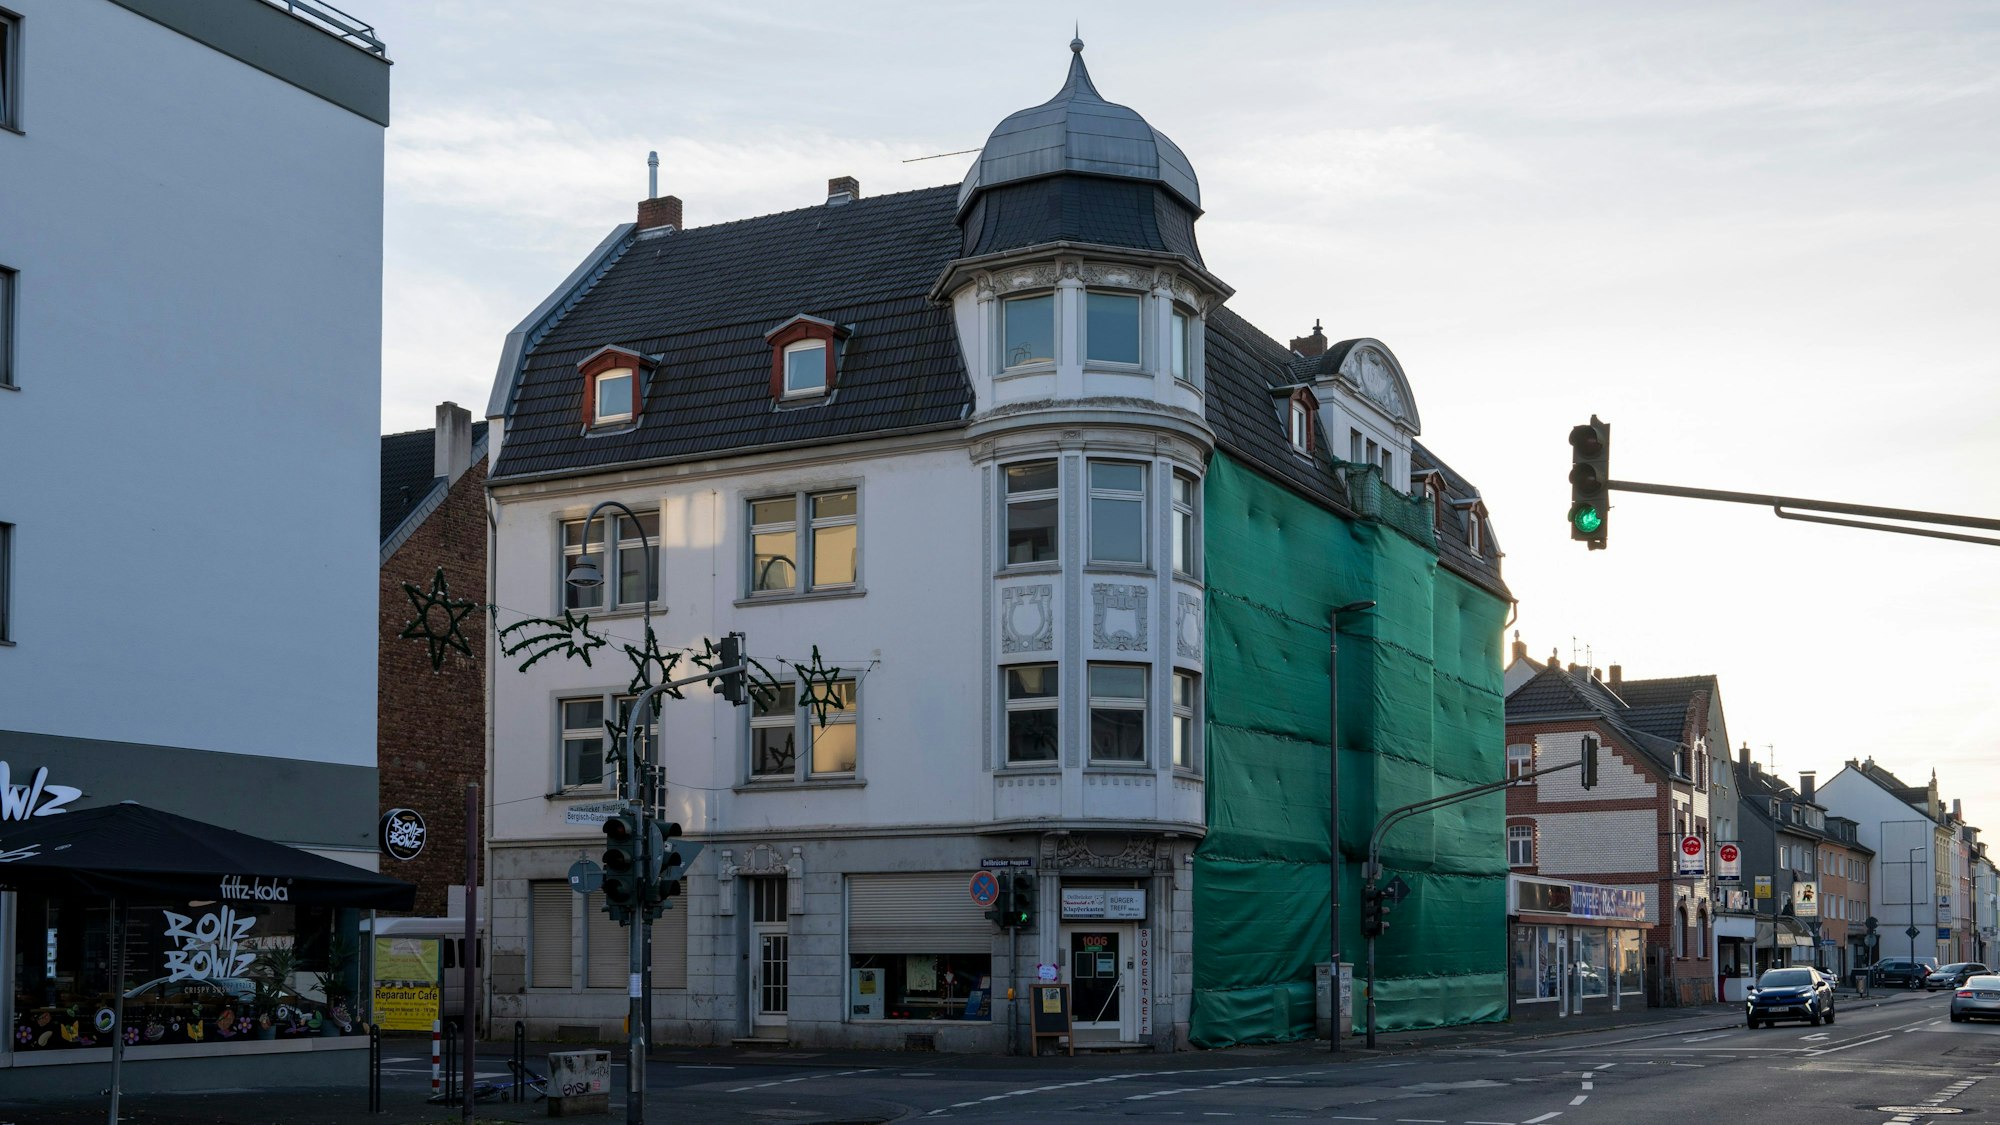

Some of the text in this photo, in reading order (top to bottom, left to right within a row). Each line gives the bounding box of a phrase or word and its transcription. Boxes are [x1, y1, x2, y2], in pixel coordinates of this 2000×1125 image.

[220, 875, 289, 901] fritz-kola
[1083, 936, 1108, 946] 1006
[184, 986, 210, 994] CRISPY
[376, 990, 438, 1001] Reparatur Café
